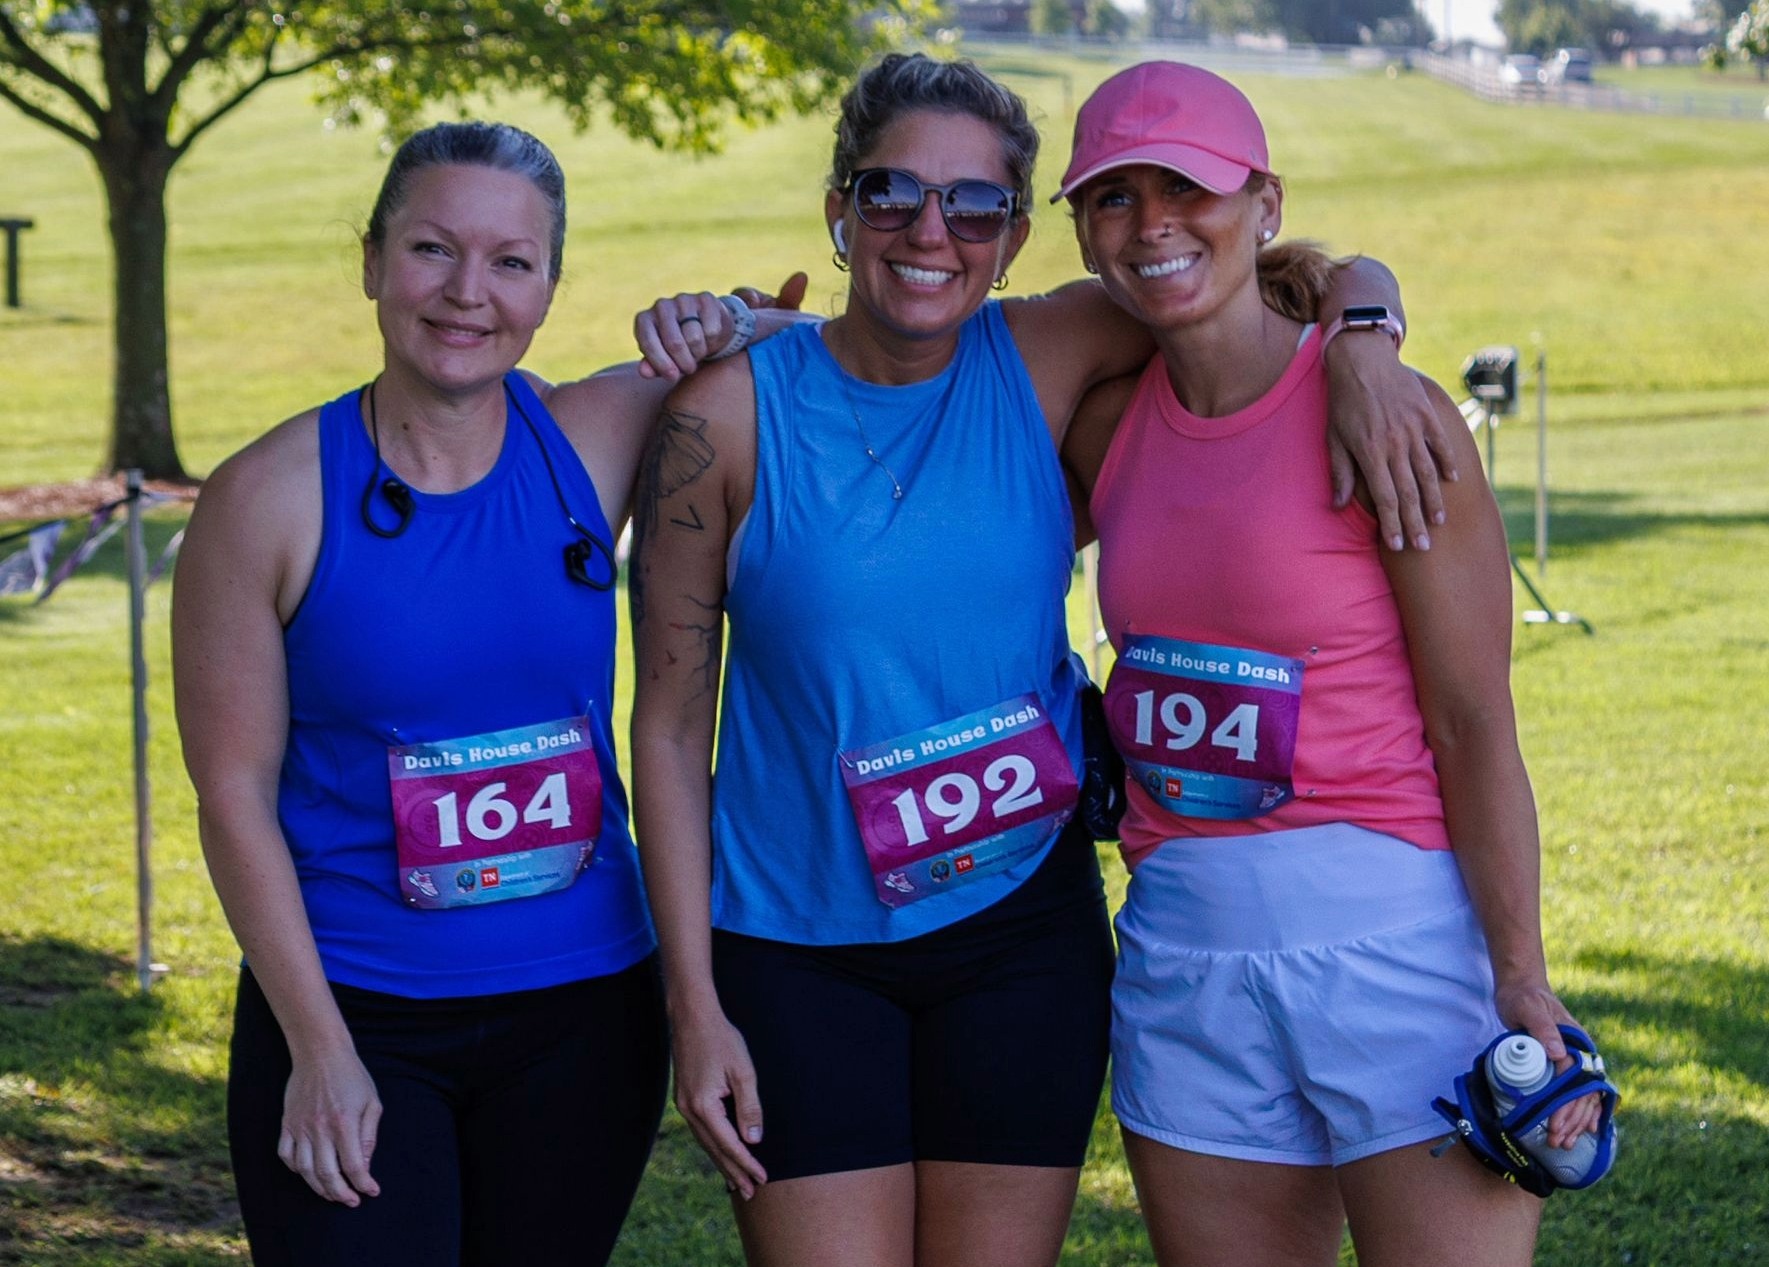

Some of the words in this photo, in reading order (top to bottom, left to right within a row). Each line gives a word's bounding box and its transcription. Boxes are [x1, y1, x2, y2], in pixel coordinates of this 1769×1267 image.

[1171, 652, 1230, 674] House
[1237, 661, 1290, 684] Dash
[857, 748, 915, 775] Davis
[920, 725, 986, 756] House
[990, 704, 1040, 733] Dash
[1134, 690, 1260, 762] 194
[404, 752, 464, 770] Davis
[469, 741, 532, 763] House
[537, 729, 581, 750] Dash
[892, 754, 1044, 847] 192
[1167, 783, 1179, 793] TN
[432, 772, 573, 848] 164
[482, 871, 497, 883] TN
[956, 857, 971, 869] TN
